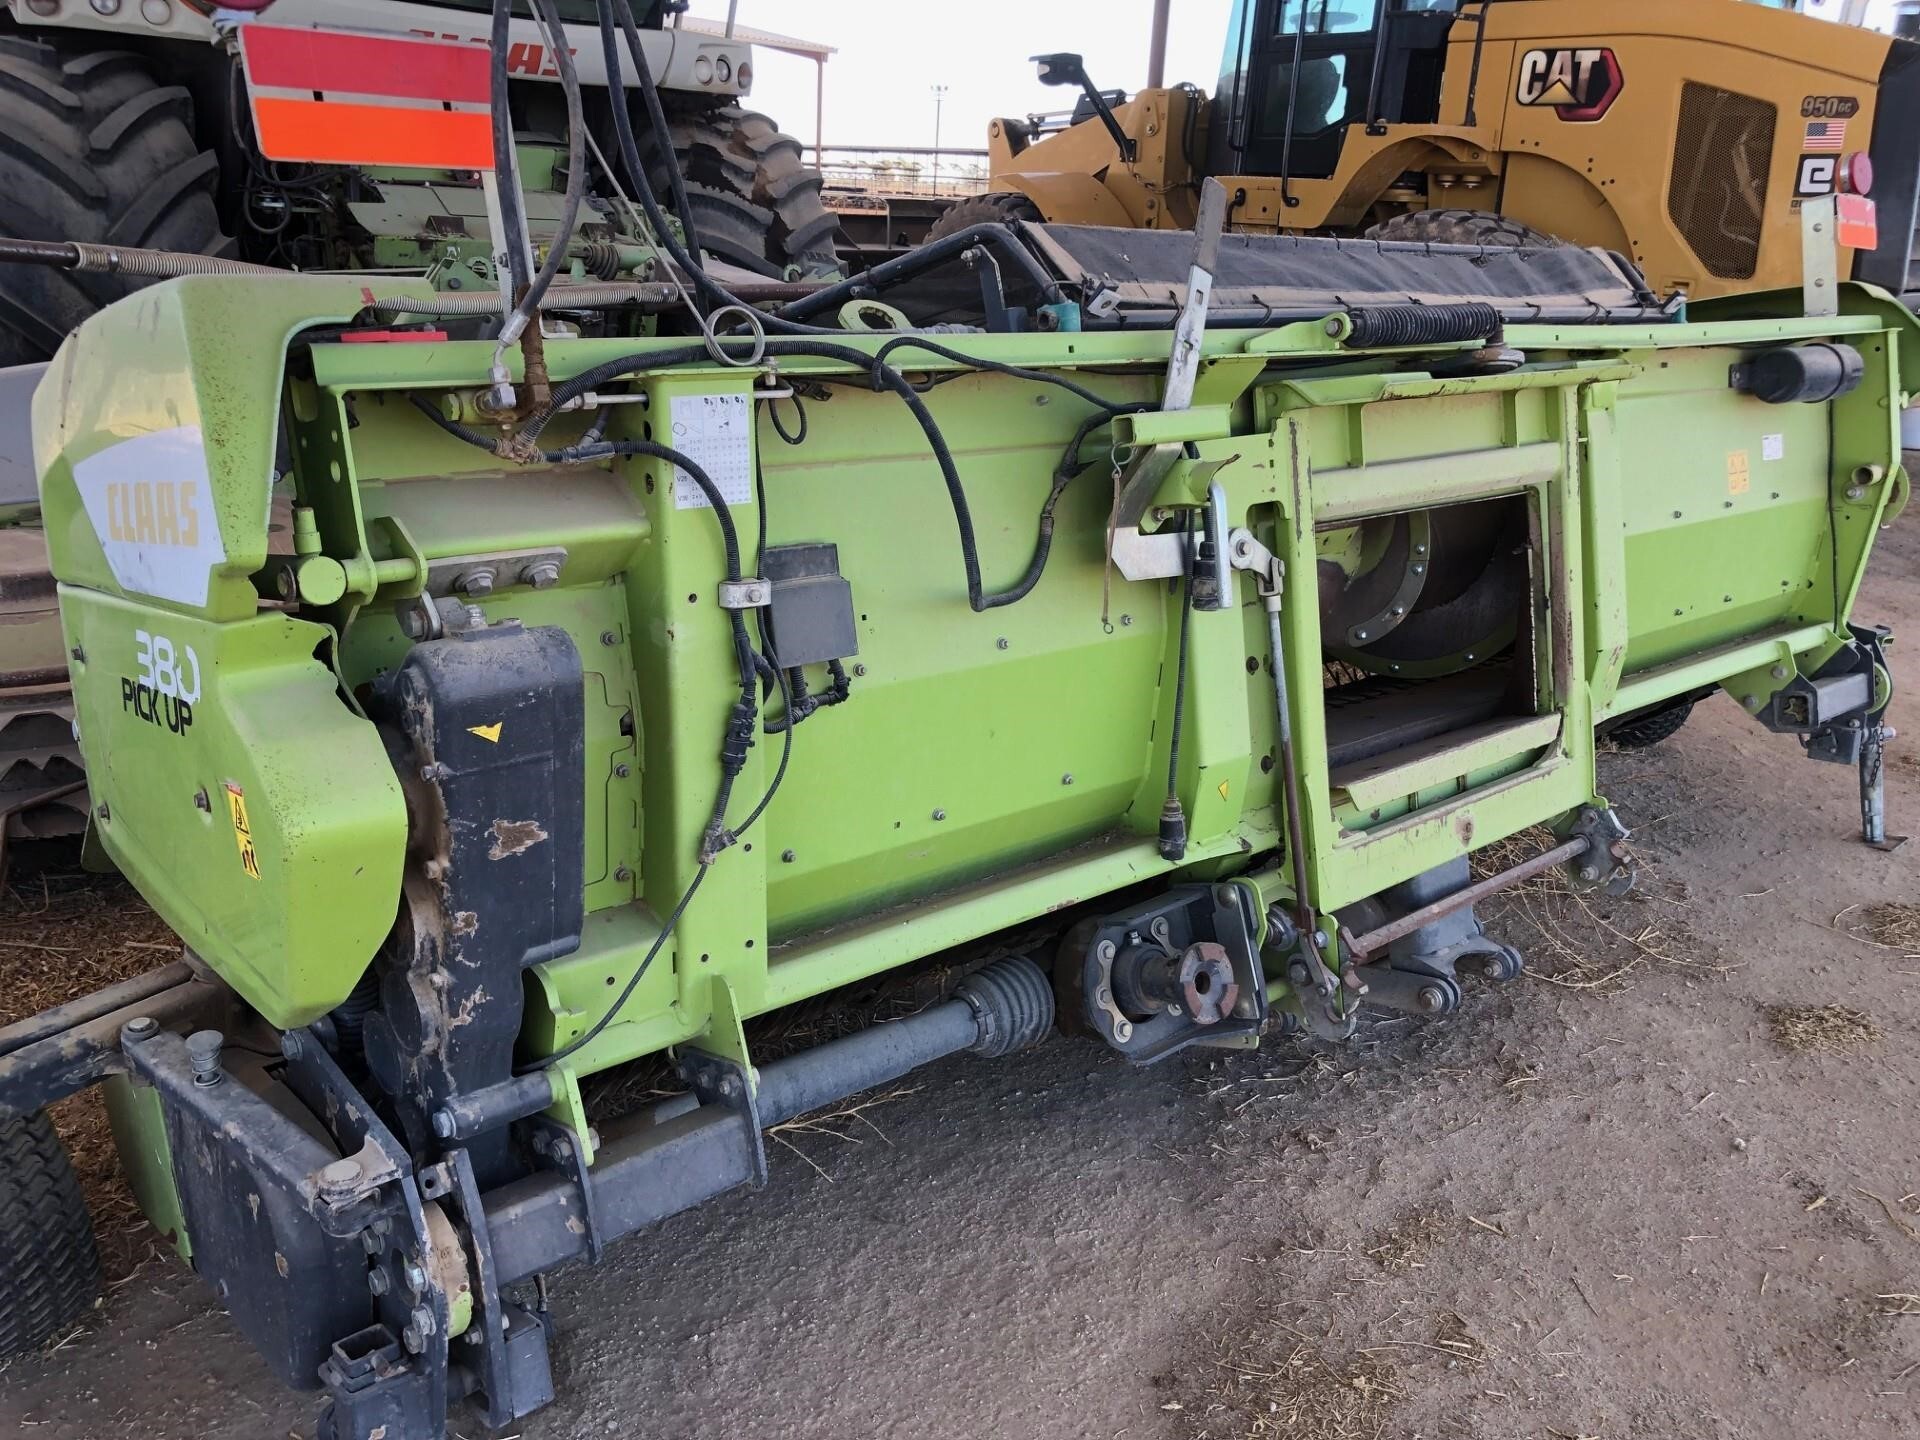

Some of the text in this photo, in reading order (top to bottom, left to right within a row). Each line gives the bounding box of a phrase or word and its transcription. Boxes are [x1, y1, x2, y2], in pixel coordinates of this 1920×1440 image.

[1518, 50, 1601, 104] CAT
[1802, 96, 1838, 117] 950
[106, 482, 198, 546] CLAAS
[135, 629, 200, 706] 380
[121, 676, 192, 737] PICK UP
